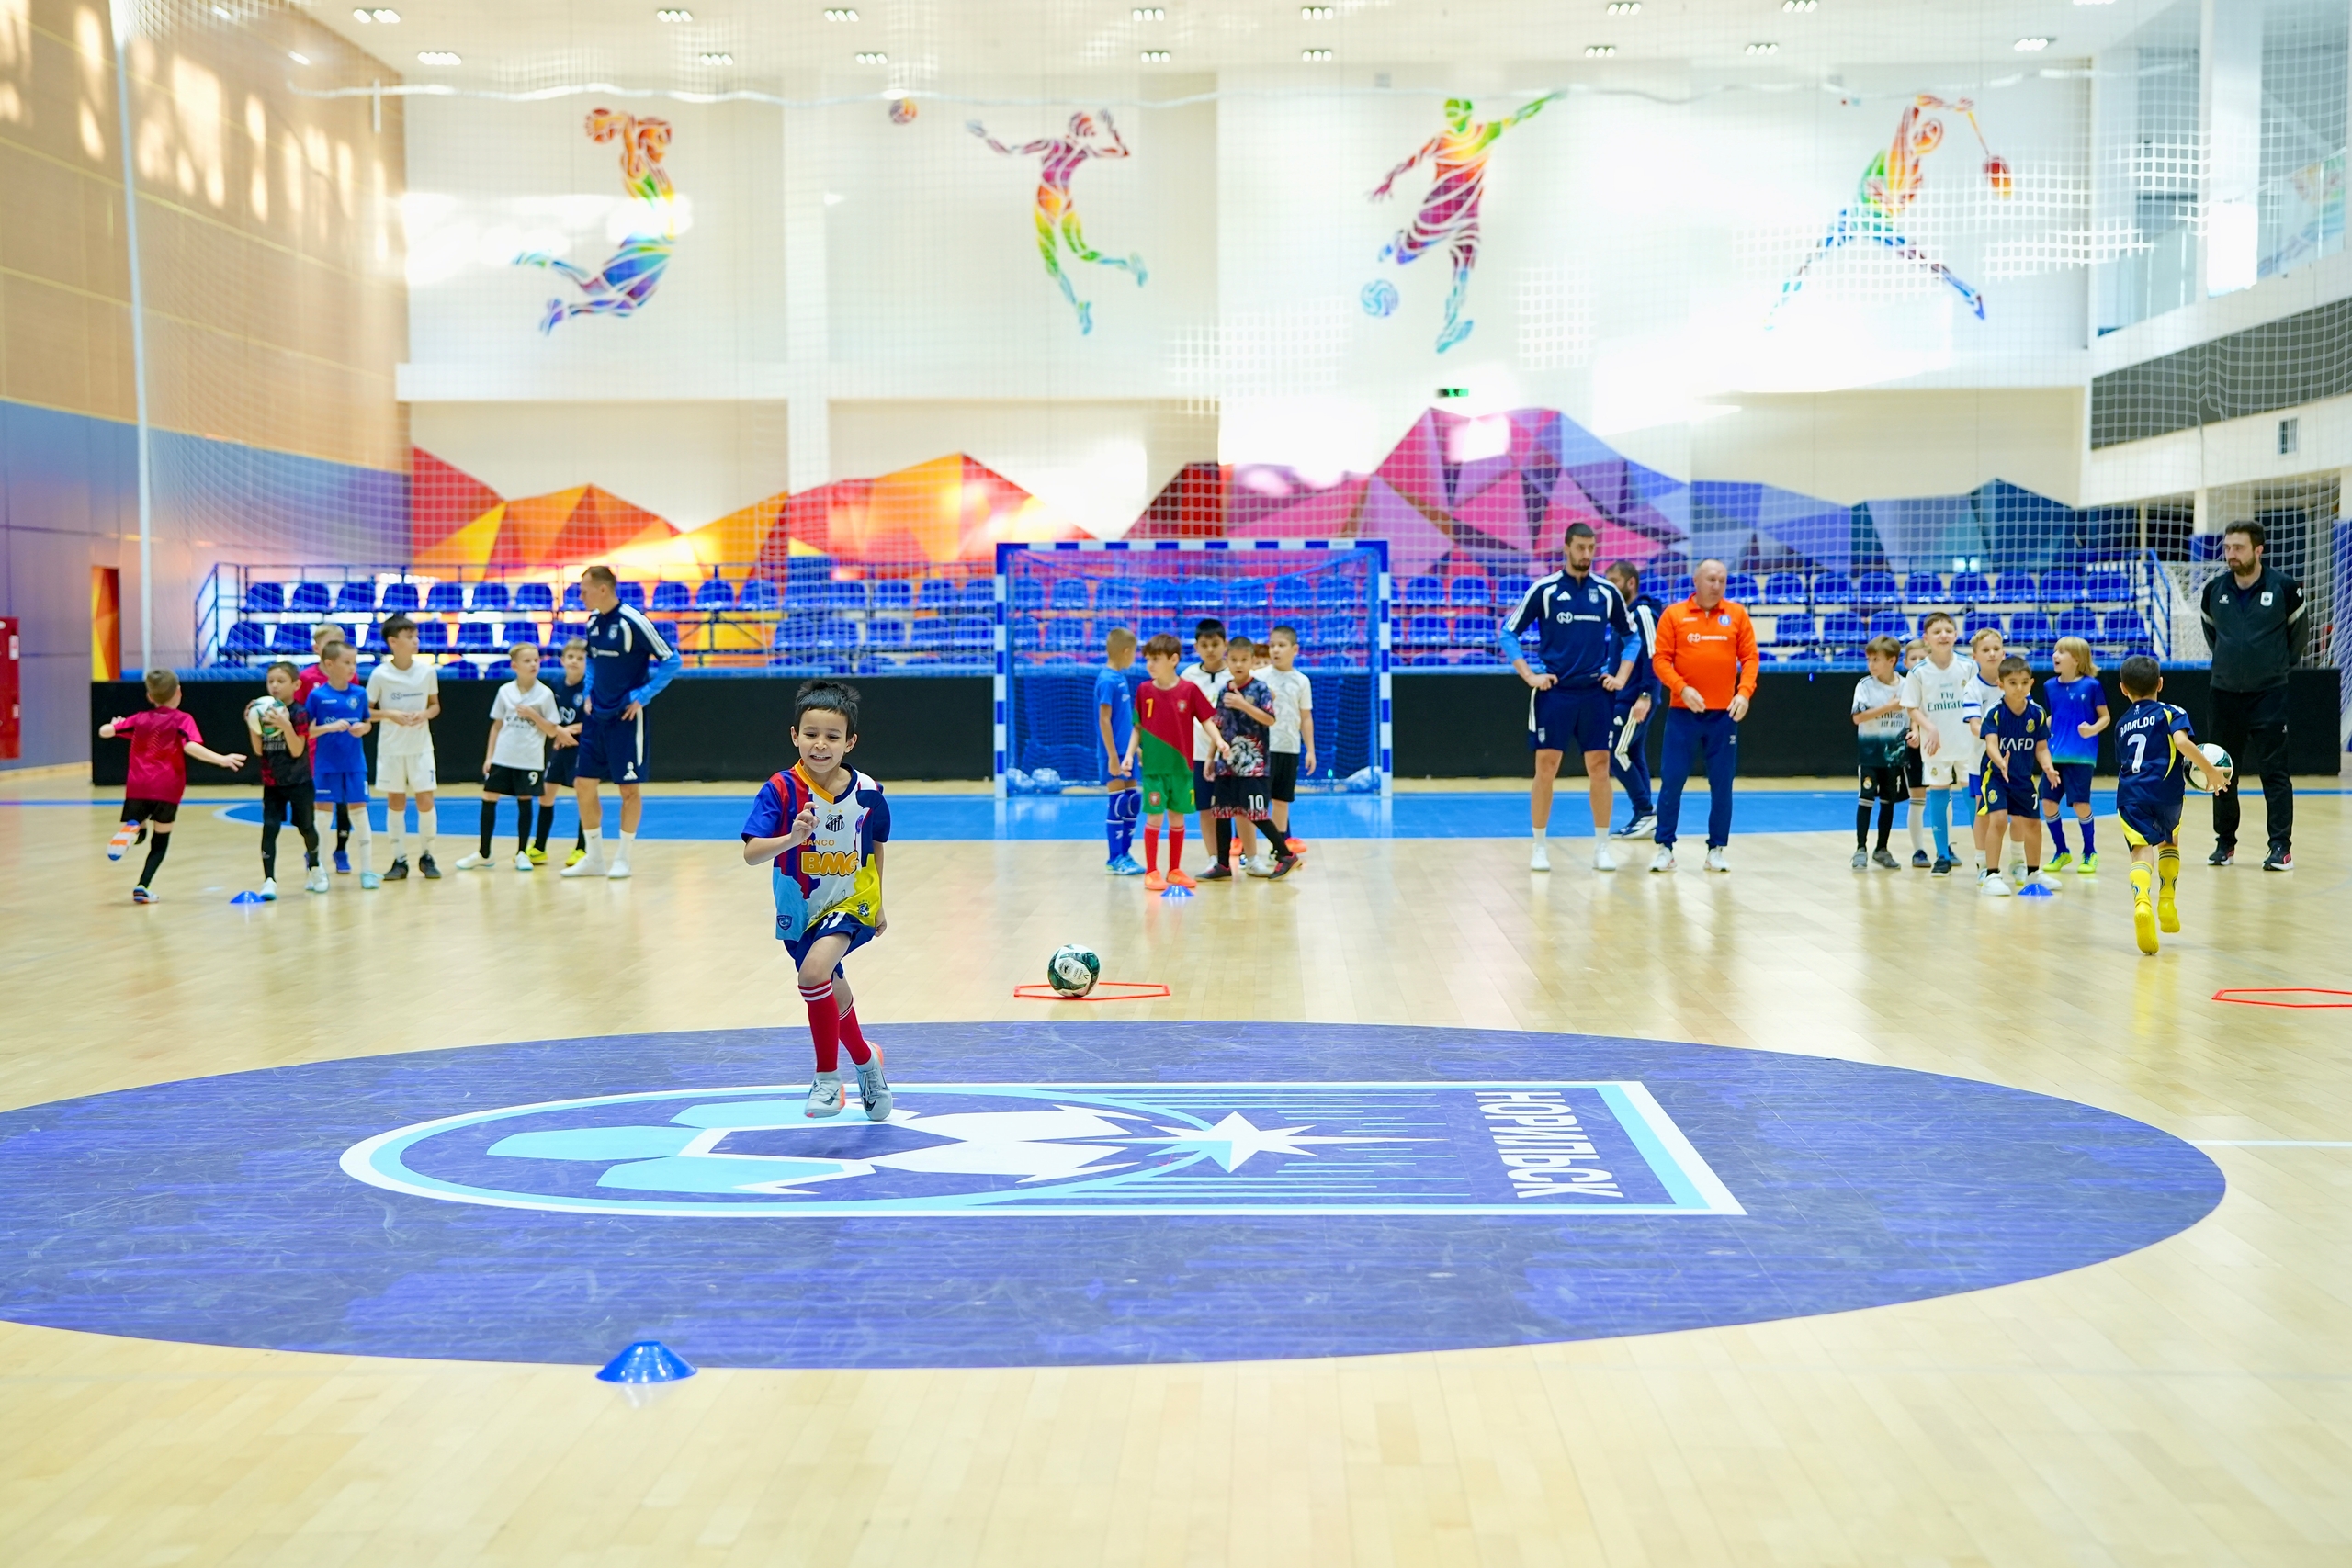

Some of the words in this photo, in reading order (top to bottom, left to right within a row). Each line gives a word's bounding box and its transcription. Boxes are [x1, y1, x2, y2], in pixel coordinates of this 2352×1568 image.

[2120, 716, 2155, 737] RONALDO
[1999, 737, 2035, 751] KAFD
[2127, 734, 2147, 773] 7
[528, 771, 538, 786] 9
[1247, 794, 1265, 812] 10
[800, 839, 835, 847] BANCO
[800, 850, 859, 876] BMG
[1474, 1091, 1625, 1199] НОРИЛЬСК
